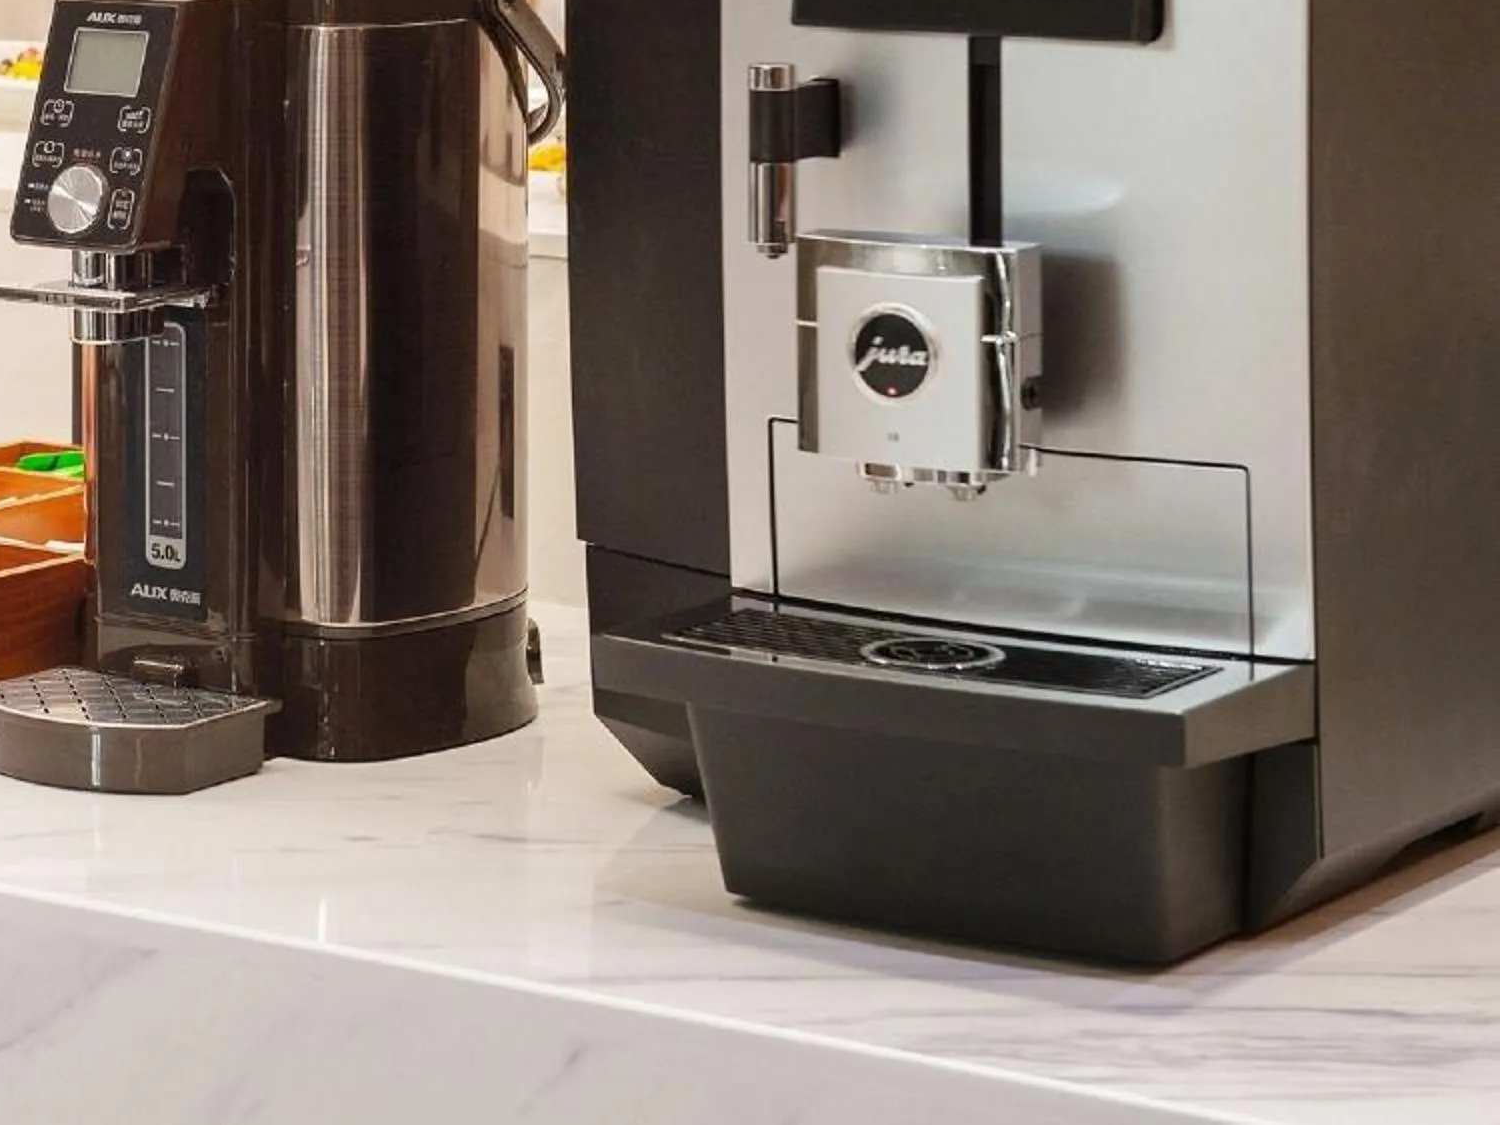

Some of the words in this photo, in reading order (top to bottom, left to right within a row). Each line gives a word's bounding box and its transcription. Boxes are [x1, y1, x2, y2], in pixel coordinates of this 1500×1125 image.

[855, 336, 929, 374] jura
[151, 542, 181, 562] 5.0L
[130, 583, 168, 600] AUX
